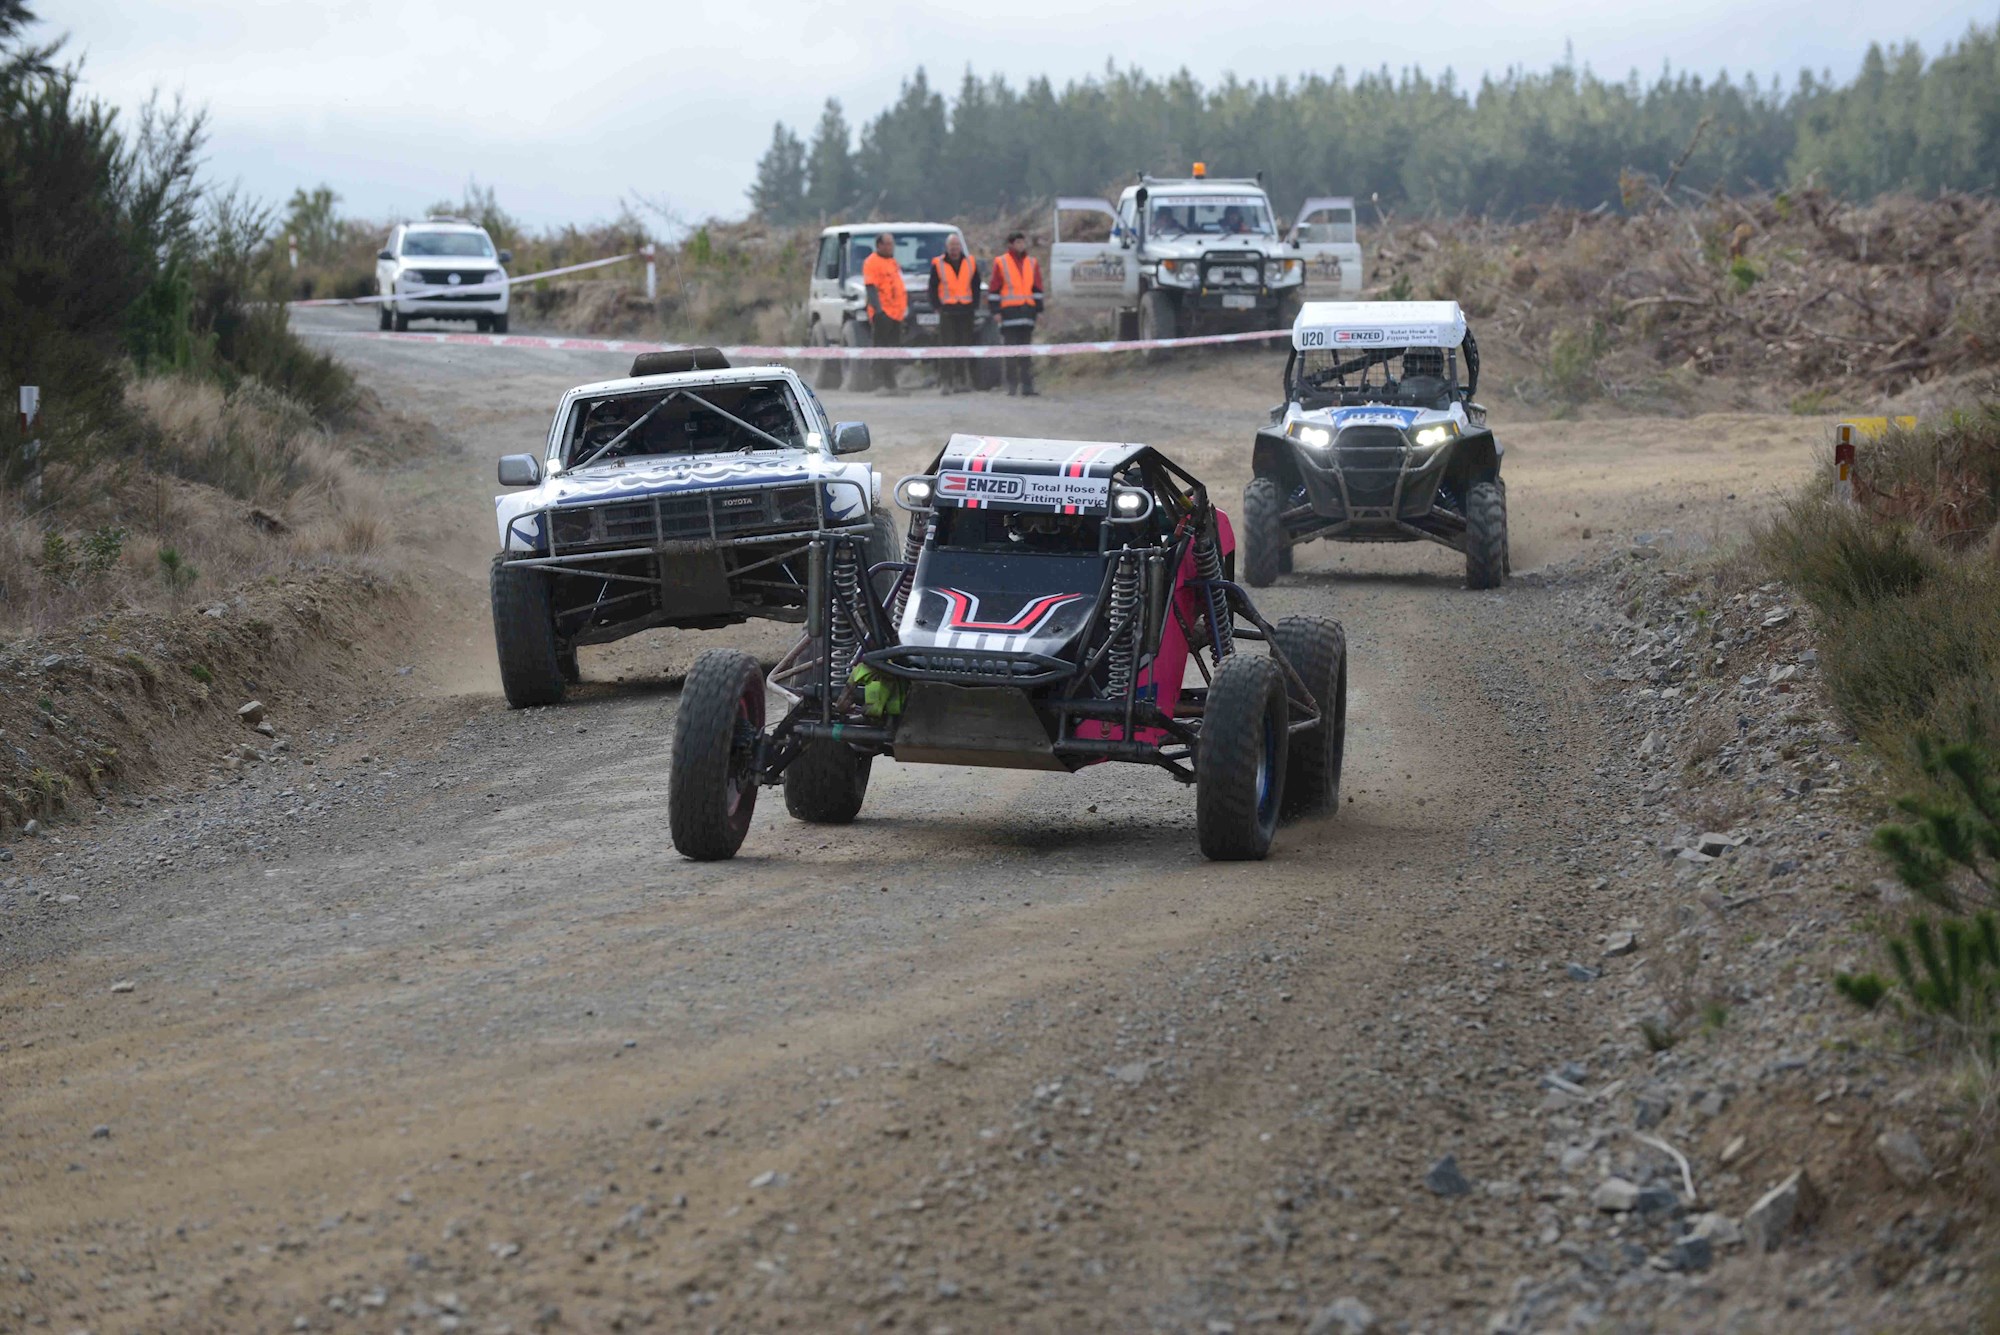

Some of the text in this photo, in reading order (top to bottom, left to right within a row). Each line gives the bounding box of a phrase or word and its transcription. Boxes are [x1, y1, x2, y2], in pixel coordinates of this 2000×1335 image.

[1302, 331, 1323, 346] U20
[1351, 332, 1380, 340] ENZED
[967, 478, 1018, 494] ENZED
[1031, 482, 1107, 494] Total Hose &
[722, 498, 753, 507] TOYOTA
[1023, 494, 1108, 506] Fitting Servic
